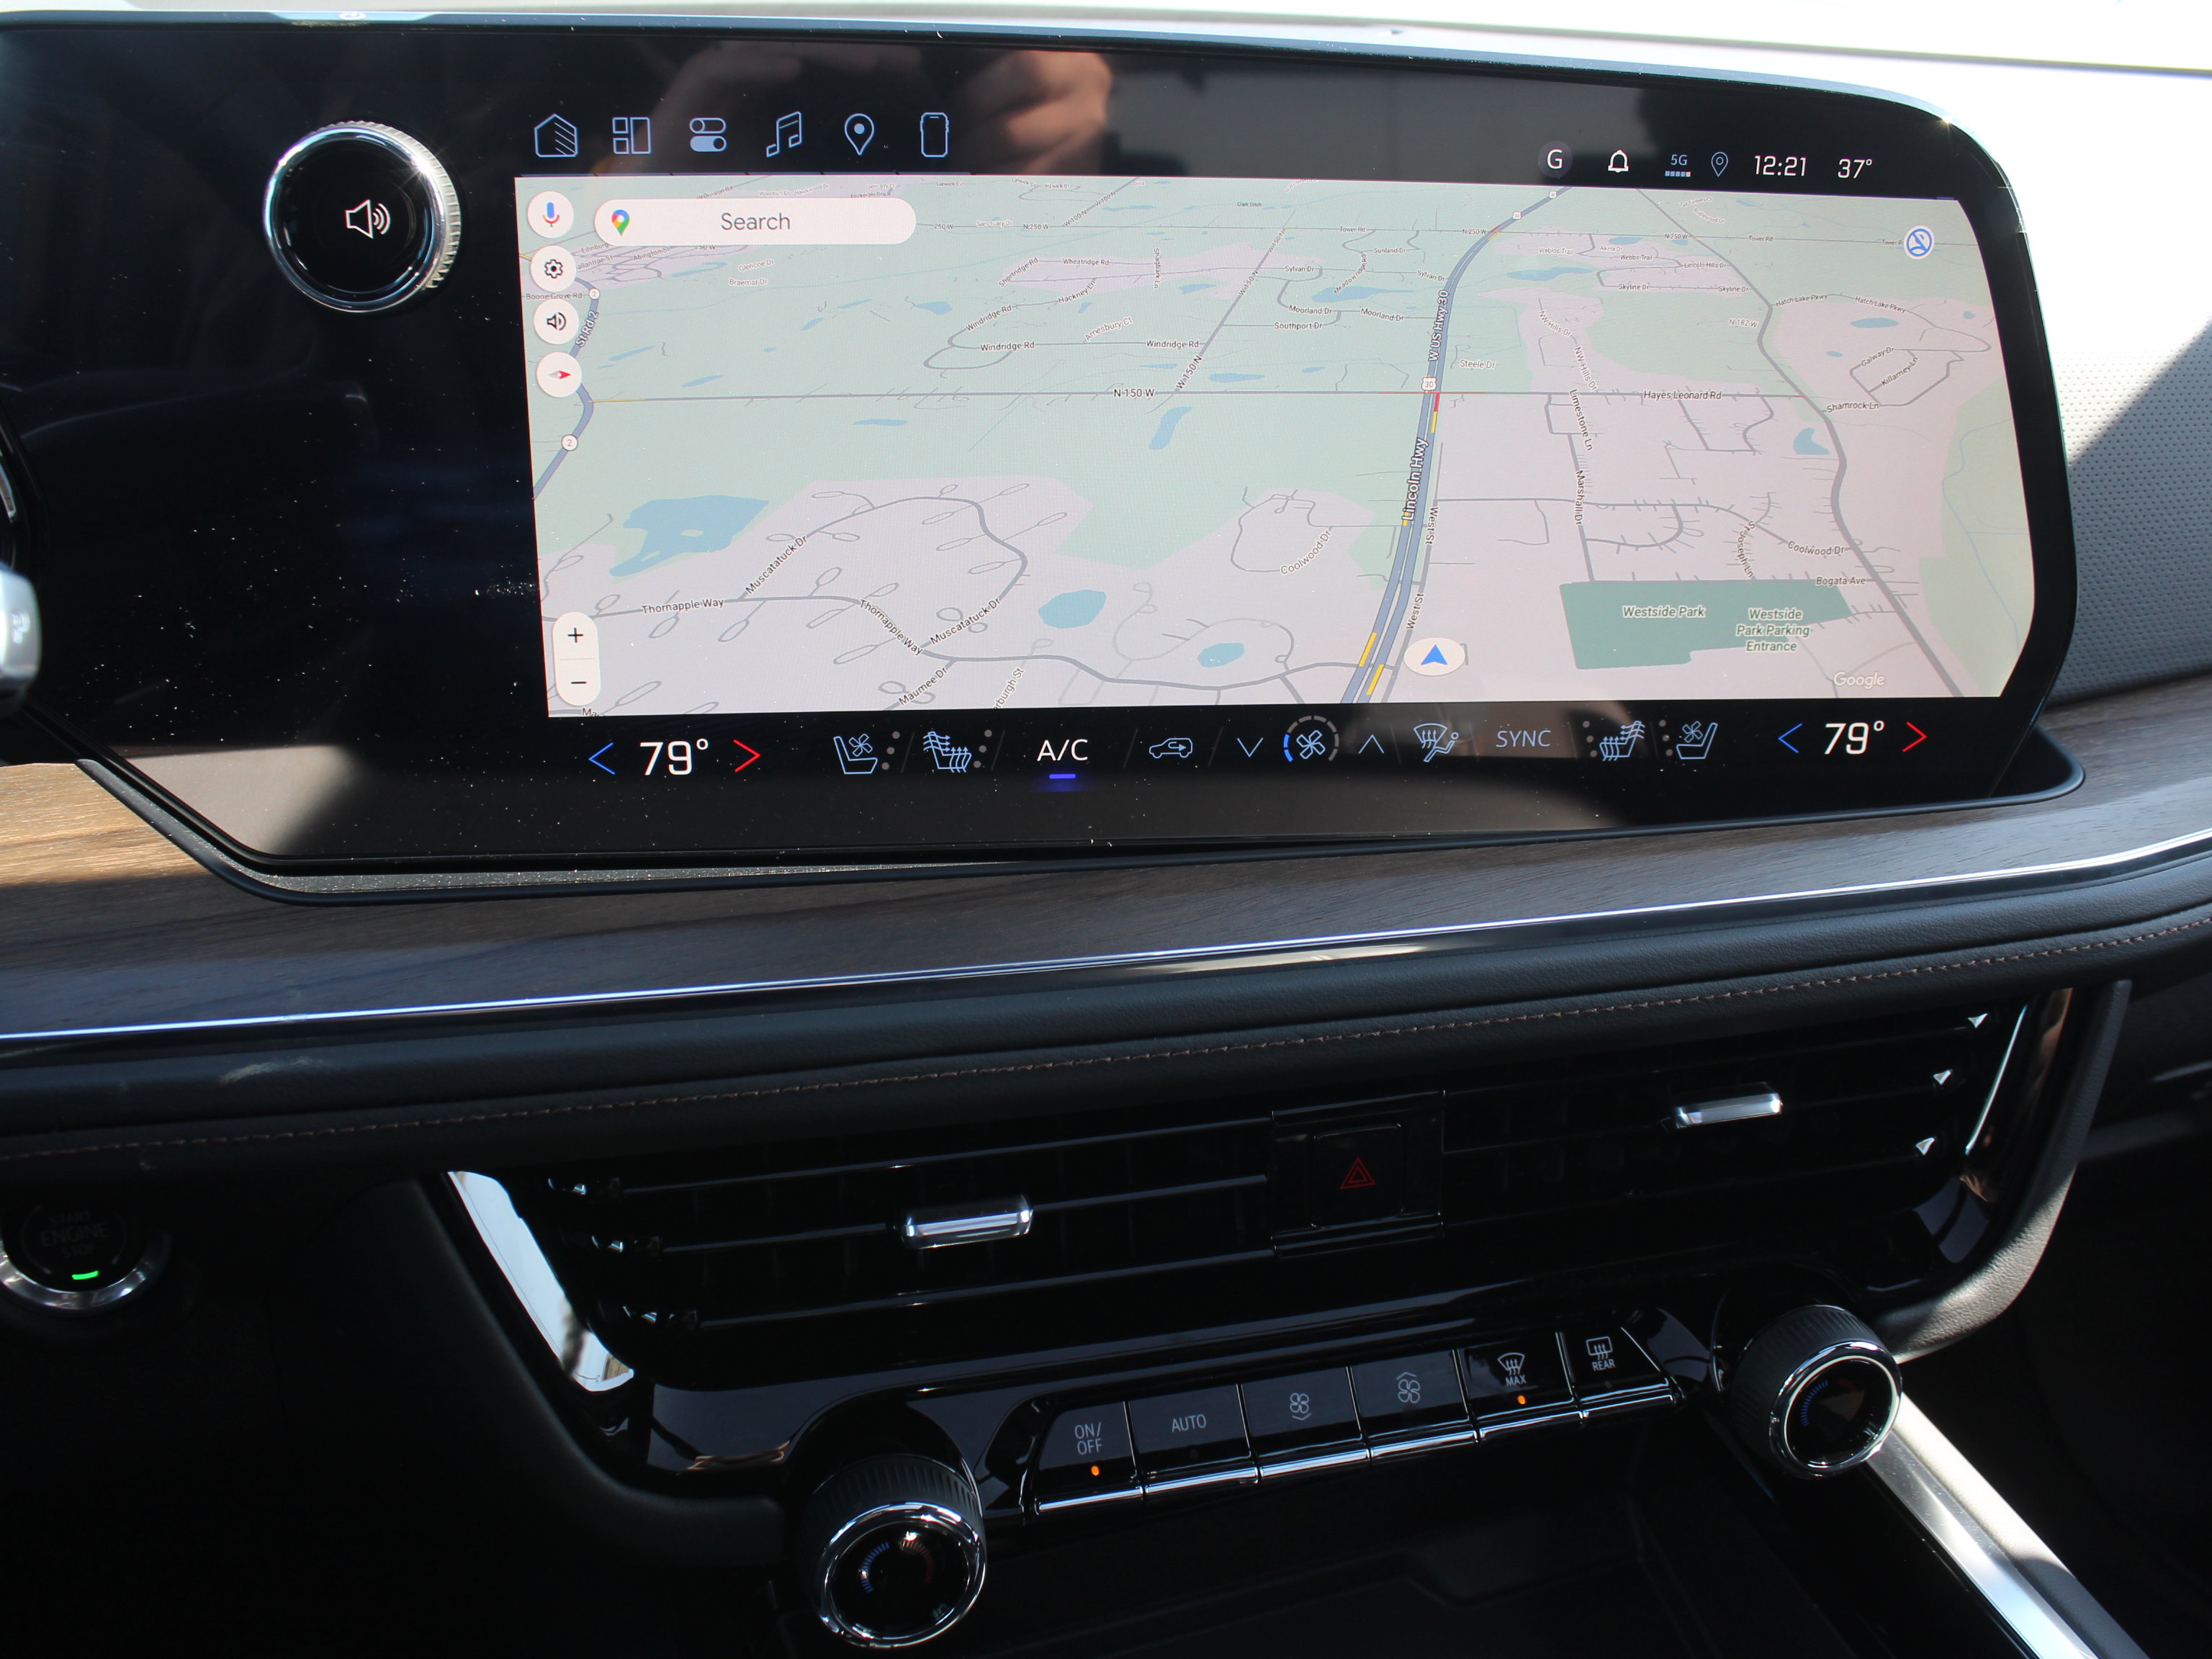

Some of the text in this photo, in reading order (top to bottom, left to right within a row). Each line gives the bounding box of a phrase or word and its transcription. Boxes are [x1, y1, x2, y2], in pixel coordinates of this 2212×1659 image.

[1547, 149, 1563, 169] G
[1671, 154, 1688, 165] 5G
[1754, 155, 1807, 176] 12:21
[1837, 158, 1873, 179] 37°
[721, 212, 791, 230] Search
[999, 257, 1038, 287] Shortridge Rd
[1417, 269, 1437, 281] Sylvan
[1058, 289, 1088, 304] Hackney
[1776, 296, 1794, 307] Hatch
[1855, 296, 1873, 306] Hatch
[1874, 300, 1888, 309] Lake
[966, 305, 1012, 331] Windridge Rd
[1289, 305, 1323, 315] Moorland
[1361, 308, 1394, 321] Moorland
[576, 333, 588, 347] St
[582, 319, 596, 335] Rd
[1085, 317, 1133, 341] Amesbury Ct
[1274, 322, 1311, 331] Southport
[1428, 289, 1449, 361] W US Hwy 30
[1539, 310, 1571, 337] NW Hills Dr
[980, 342, 1022, 351] Windridge
[1146, 340, 1186, 349] Windridge
[1460, 359, 1484, 368] Steele
[1861, 346, 1894, 367] Galway Dr
[1175, 355, 1202, 390] W 150 N
[1574, 346, 1597, 391] NW Hills Dr
[1881, 356, 1919, 387] Killarney Ln
[1644, 390, 1671, 400] Hayes
[1673, 391, 1708, 400] Leonard
[1826, 401, 1867, 413] Shamrock
[1569, 389, 1593, 451] Limestone Ln
[1402, 437, 1429, 521] Lincoln Hwy
[1574, 470, 1585, 526] Marshall Dr
[1425, 506, 1439, 545] West St
[1280, 529, 1332, 575] Coolwood Dr
[1736, 521, 1755, 577] St Joseph Ln
[1787, 541, 1845, 556] Coolwood Dr
[745, 534, 808, 595] Muscatatuck Dr
[1816, 577, 1847, 586] Bogata
[642, 598, 724, 615] Thornapple Way
[1406, 593, 1424, 630] West St
[1622, 605, 1706, 618] Westside Park
[1748, 608, 1803, 621] Westside
[860, 599, 923, 656] Thornapple Way
[930, 598, 1001, 645] Muscatatuck Dr
[1736, 624, 1810, 639] Park Parking
[1746, 641, 1798, 652] Entrance
[1012, 667, 1024, 679] St
[1833, 673, 1885, 690] Google
[898, 667, 948, 706] Maumee Dr
[1496, 730, 1551, 749] SYNC
[1824, 721, 1885, 755] 79°
[639, 737, 710, 776] 79°
[1038, 739, 1088, 762] A/C
[40, 1222, 109, 1247] ENGINE
[1591, 1358, 1617, 1372] REAR
[1506, 1374, 1527, 1386] MAX
[1074, 1421, 1102, 1440] ON/
[1171, 1413, 1208, 1433] AUTO
[1076, 1438, 1103, 1456] OFF
